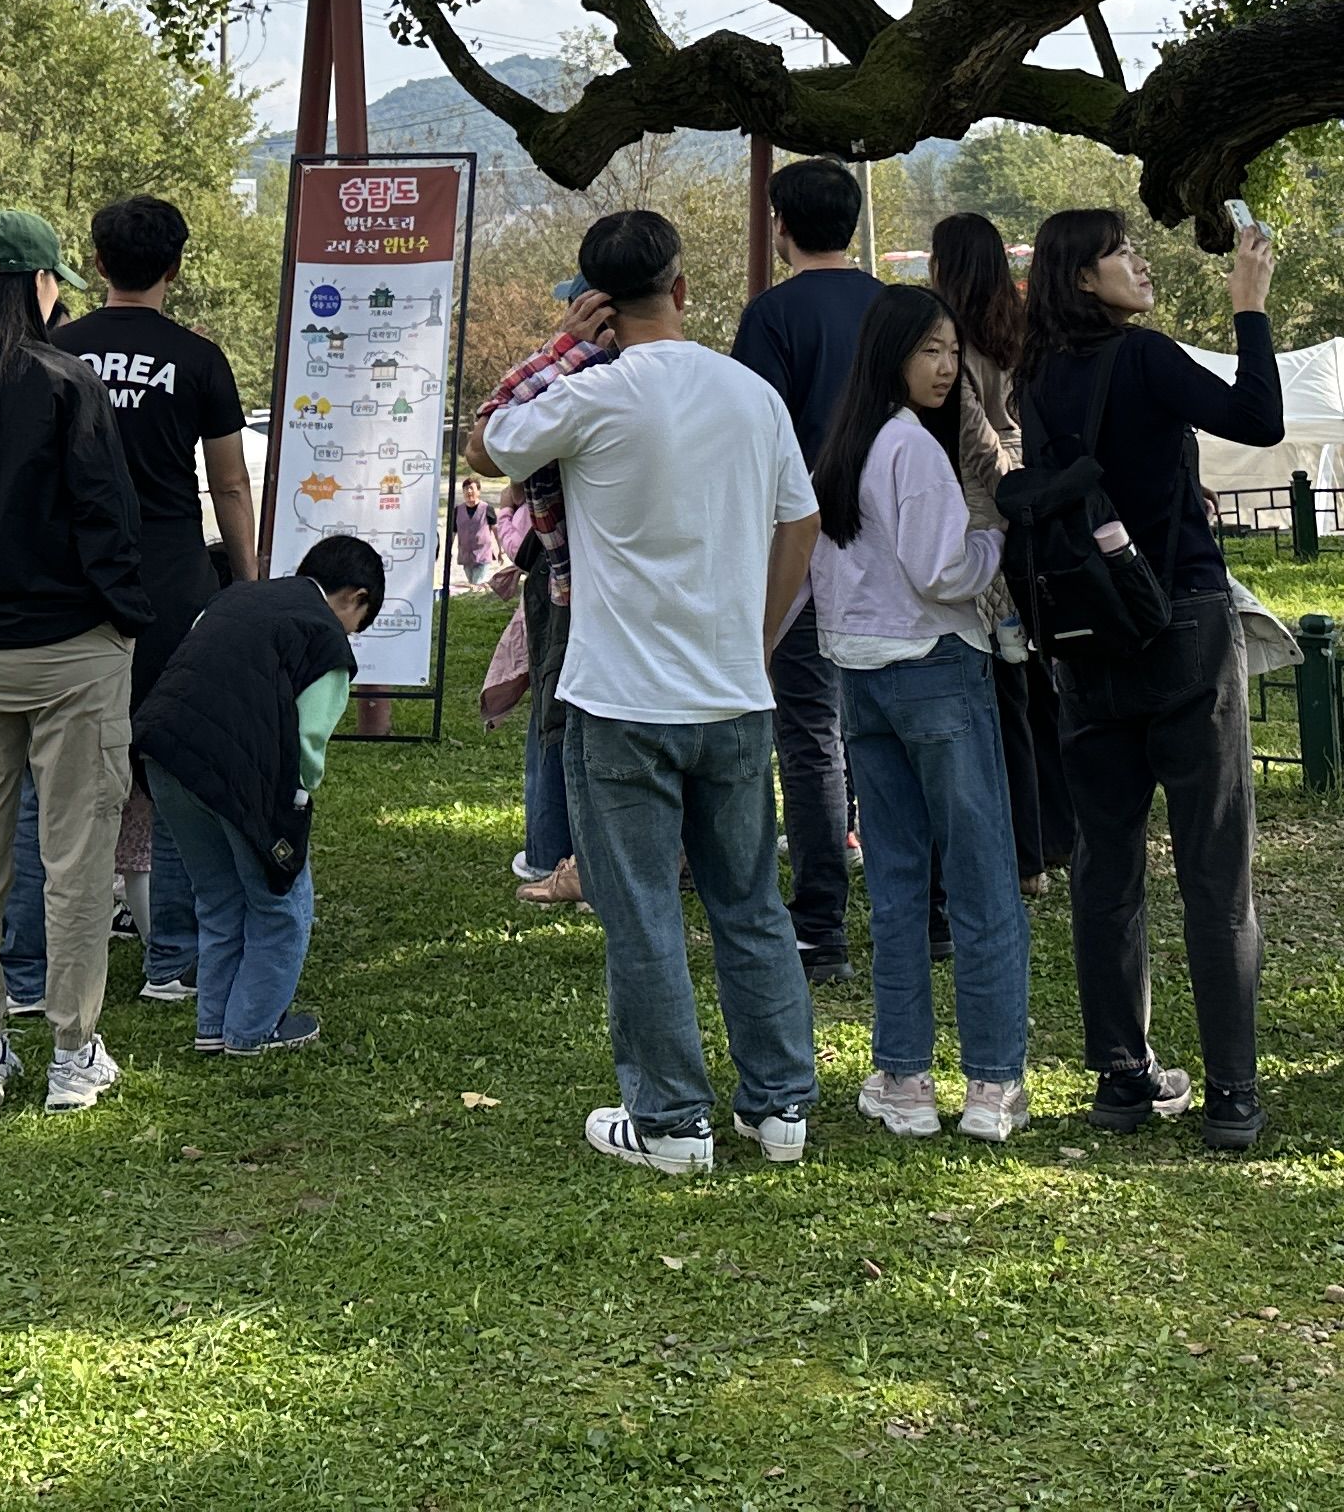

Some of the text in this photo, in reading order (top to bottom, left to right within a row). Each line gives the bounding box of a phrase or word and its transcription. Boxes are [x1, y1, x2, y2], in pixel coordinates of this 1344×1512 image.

[339, 177, 419, 213] 승람도
[344, 216, 415, 232] 행단스토리
[324, 236, 430, 254] 고려 충신 임난수
[78, 352, 176, 395] OREA
[108, 388, 146, 408] MY
